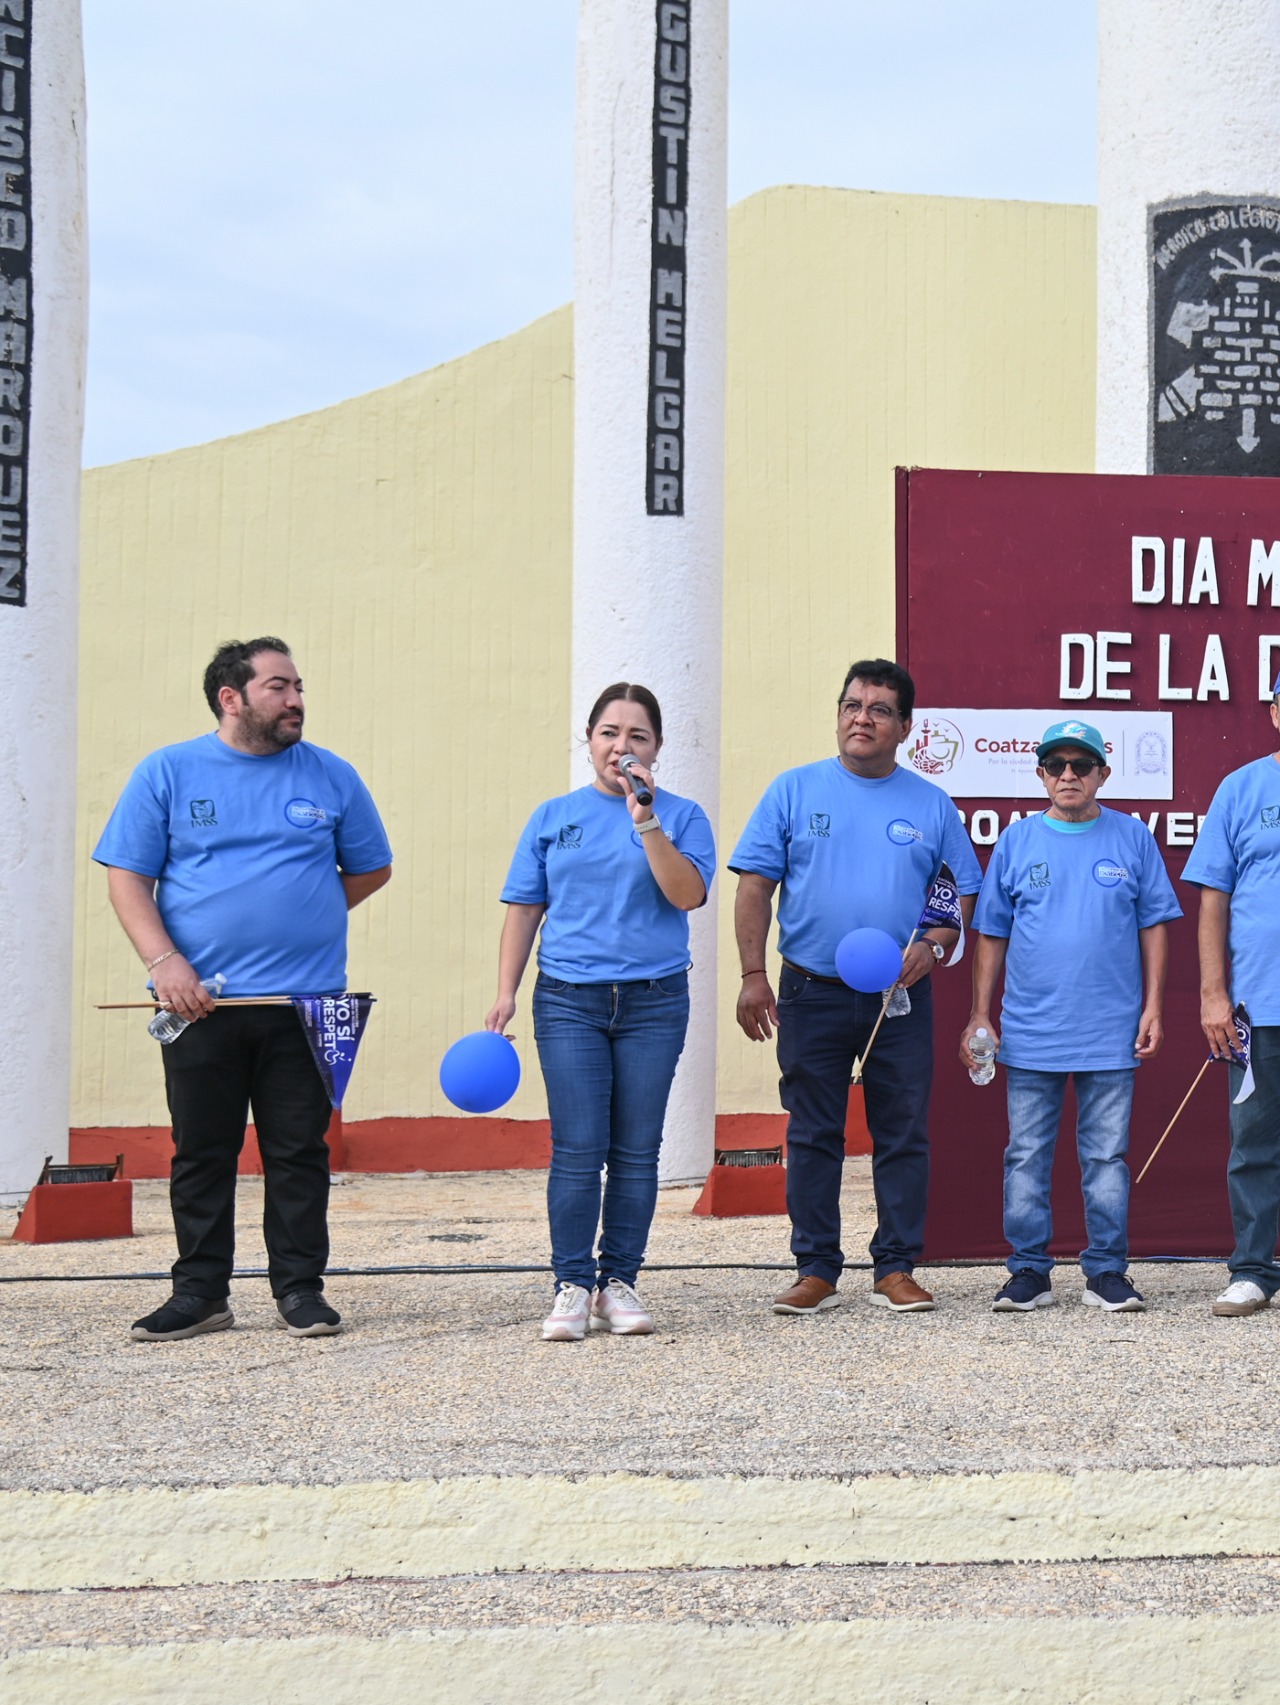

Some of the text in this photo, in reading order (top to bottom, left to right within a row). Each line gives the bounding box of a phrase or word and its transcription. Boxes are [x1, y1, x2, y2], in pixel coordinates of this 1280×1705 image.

[653, 0, 688, 512] GUSTIN MELGAR
[1131, 535, 1220, 605] DIA
[1059, 631, 1132, 700] DE
[1158, 633, 1230, 701] LA
[190, 818, 218, 828] IMSS
[808, 830, 831, 838] IMSS
[556, 841, 582, 850] IMSS
[934, 884, 953, 900] YO
[1029, 879, 1052, 890] IMSS
[928, 896, 961, 921] RESPE
[336, 998, 350, 1021] YO
[336, 1025, 355, 1042] SÍ
